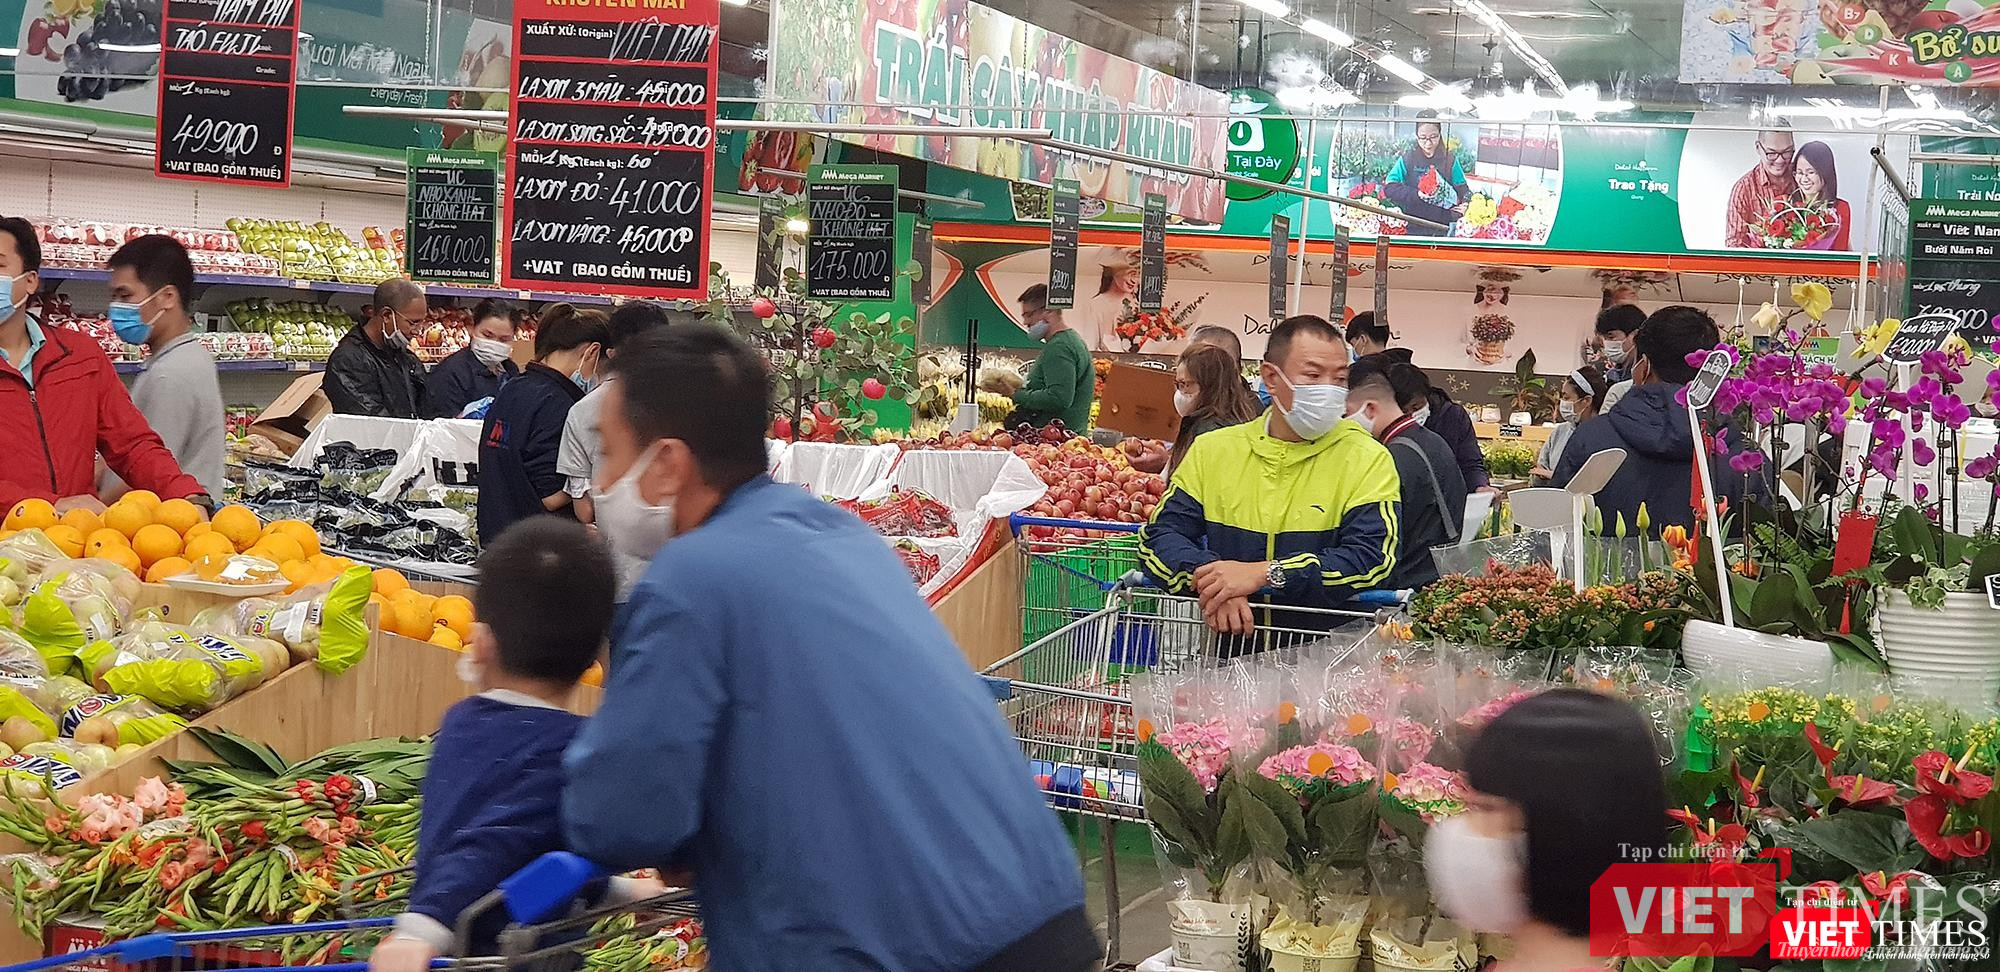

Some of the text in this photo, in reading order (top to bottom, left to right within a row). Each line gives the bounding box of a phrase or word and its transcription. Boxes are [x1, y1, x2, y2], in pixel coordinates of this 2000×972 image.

[526, 22, 556, 35] XUẤT
[1864, 29, 1874, 39] D
[1888, 53, 1900, 66] K
[1953, 66, 1964, 78] A
[876, 28, 967, 124] TRÁI
[973, 55, 1040, 130] CÂY
[273, 146, 283, 155] Đ
[192, 162, 219, 173] (BAO
[1233, 155, 1282, 170] Tại Đây
[1608, 179, 1669, 194] Trao Tặng
[1975, 246, 1994, 256] Roi
[523, 259, 564, 274] +VAT
[572, 263, 606, 277] (BAO
[810, 249, 887, 280] 175.000
